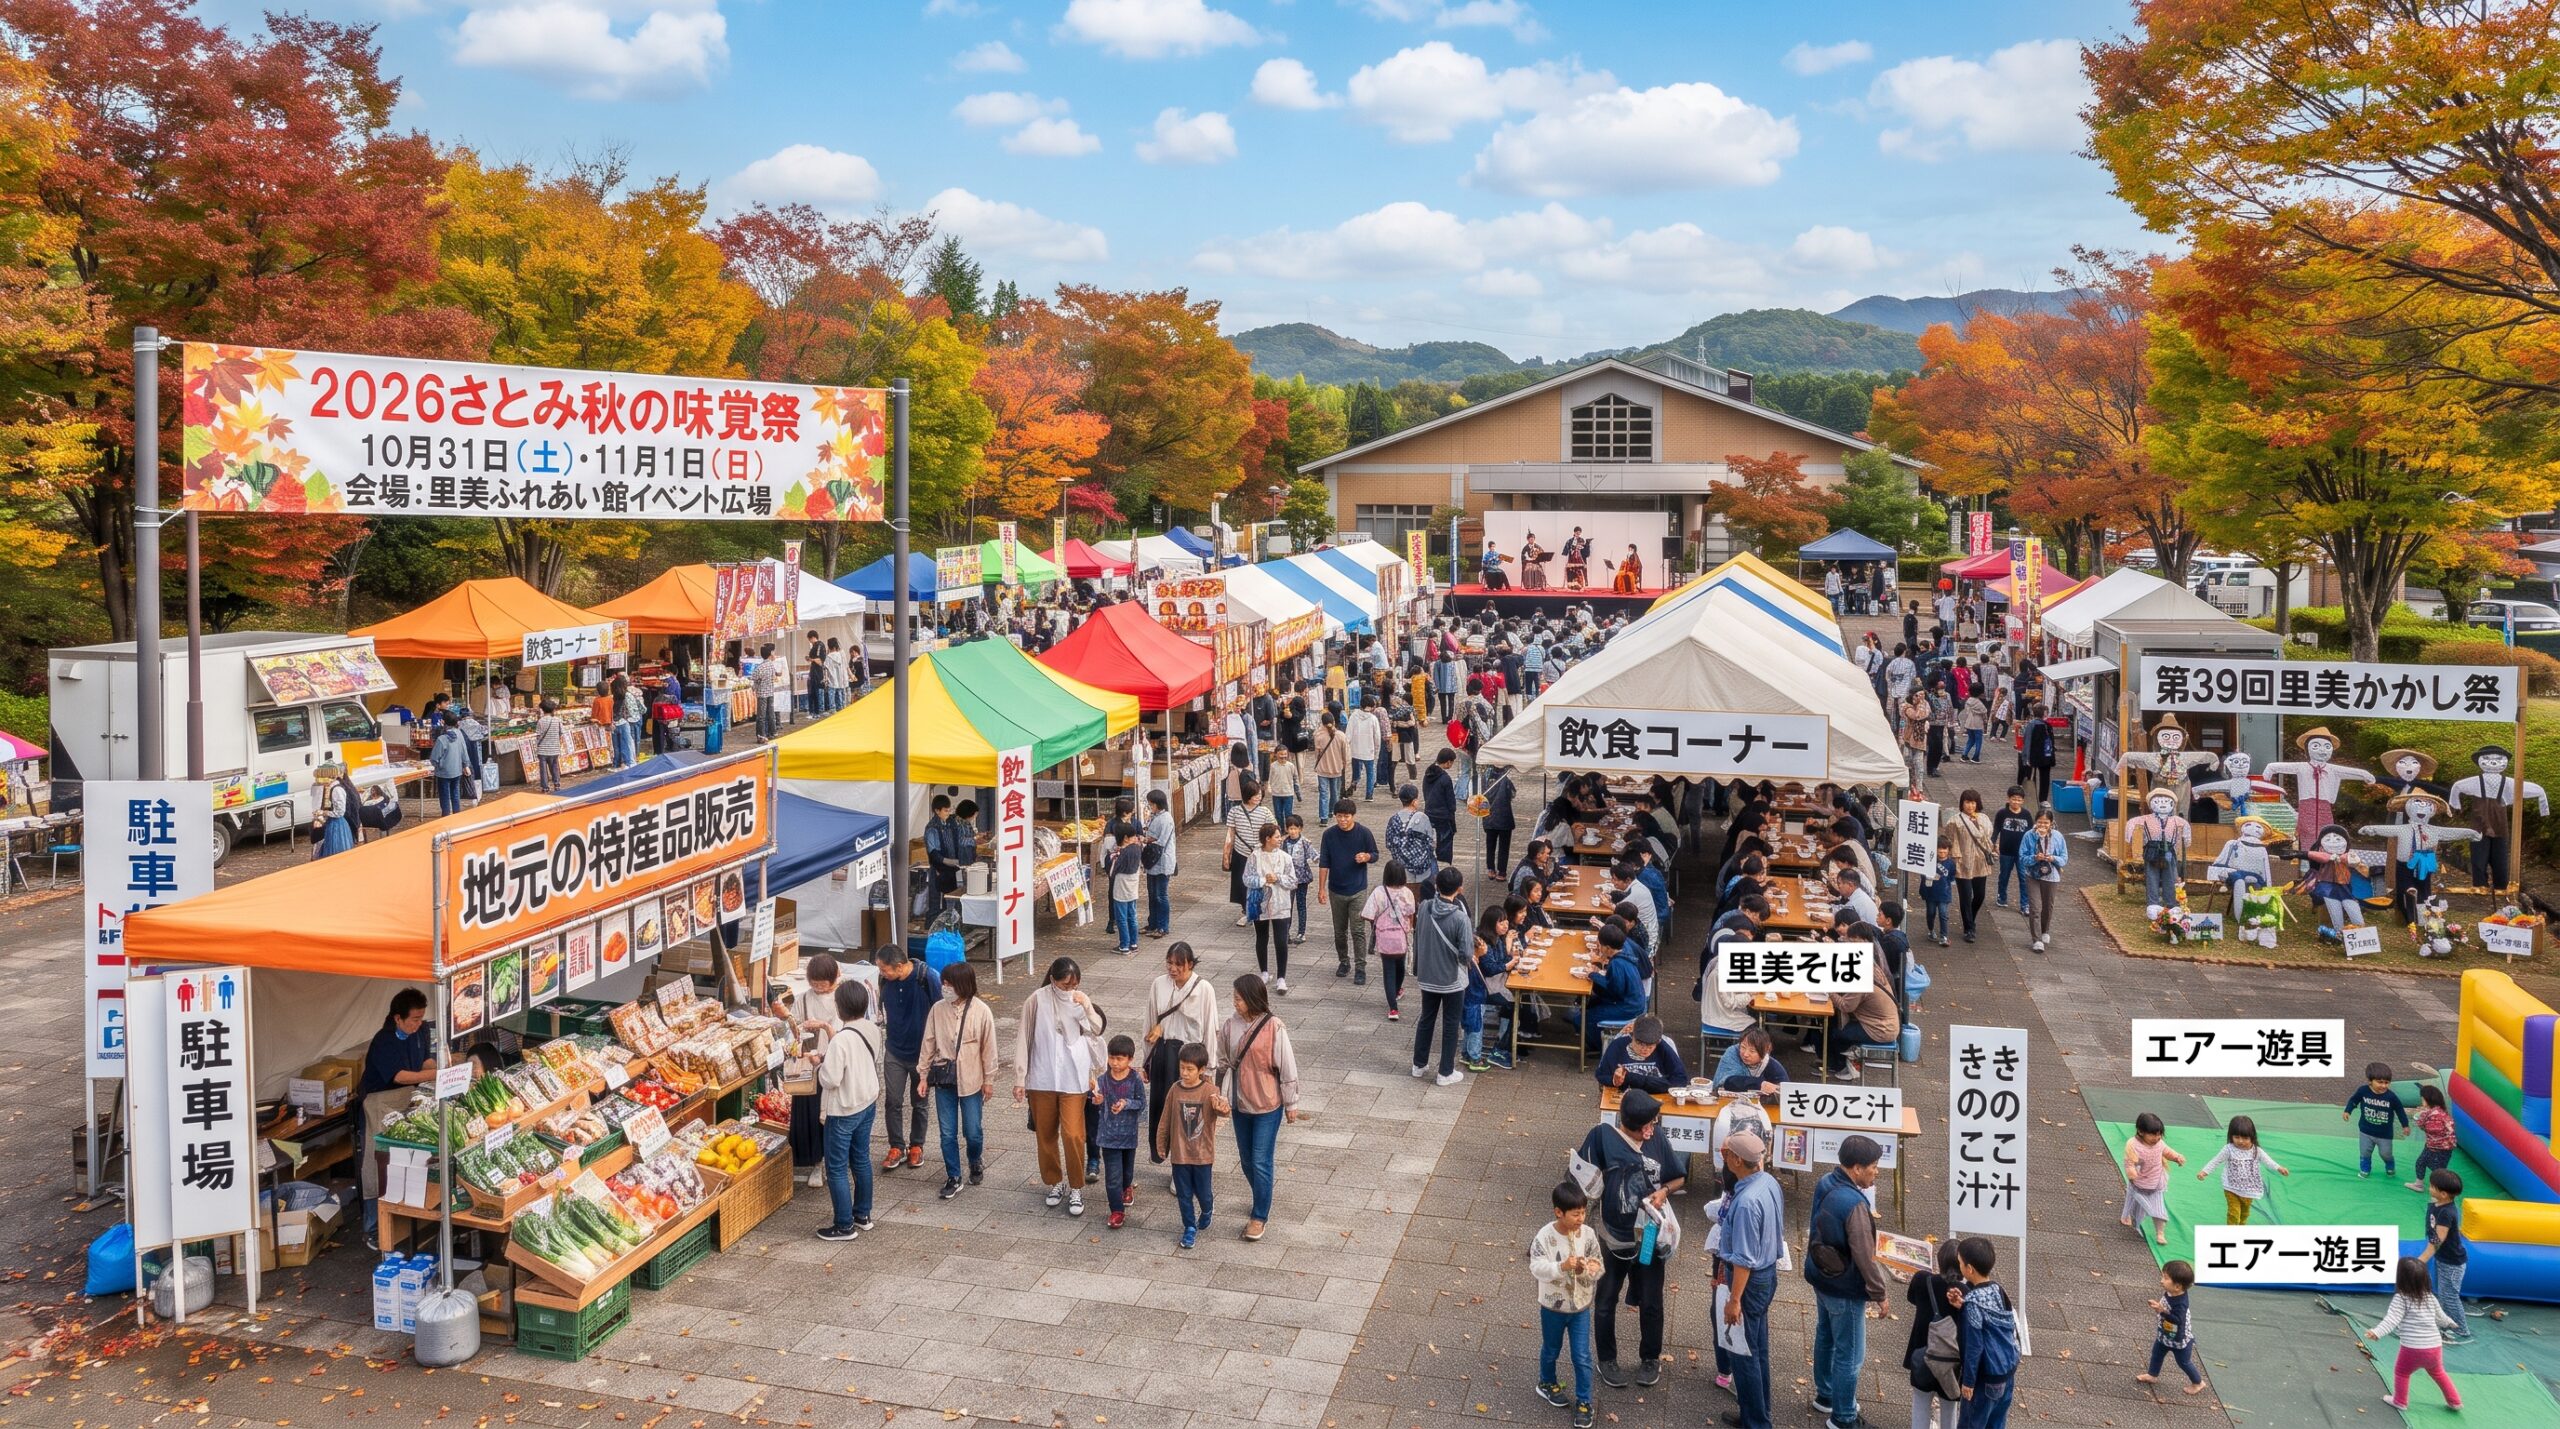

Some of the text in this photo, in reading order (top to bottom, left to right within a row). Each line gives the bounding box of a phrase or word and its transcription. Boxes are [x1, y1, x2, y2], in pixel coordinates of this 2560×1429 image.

[311, 366, 801, 443] 2026さとみ秋の味覚祭
[345, 474, 773, 516] 会場：里美ふれあい館イベント広場
[526, 633, 597, 662] 飲食コーナー
[2156, 665, 2502, 714] 第39回里美かかし祭
[1559, 716, 1810, 764] 飲食コーナー
[462, 779, 756, 926] 地元の特産品販売
[1001, 755, 1027, 945] 飲食コーナー
[180, 1019, 236, 1191] 駐車場
[1787, 1089, 1895, 1123] きのこ汁
[1956, 1042, 1989, 1209] きのこ汁
[1991, 1045, 2021, 1211] きのこ汁
